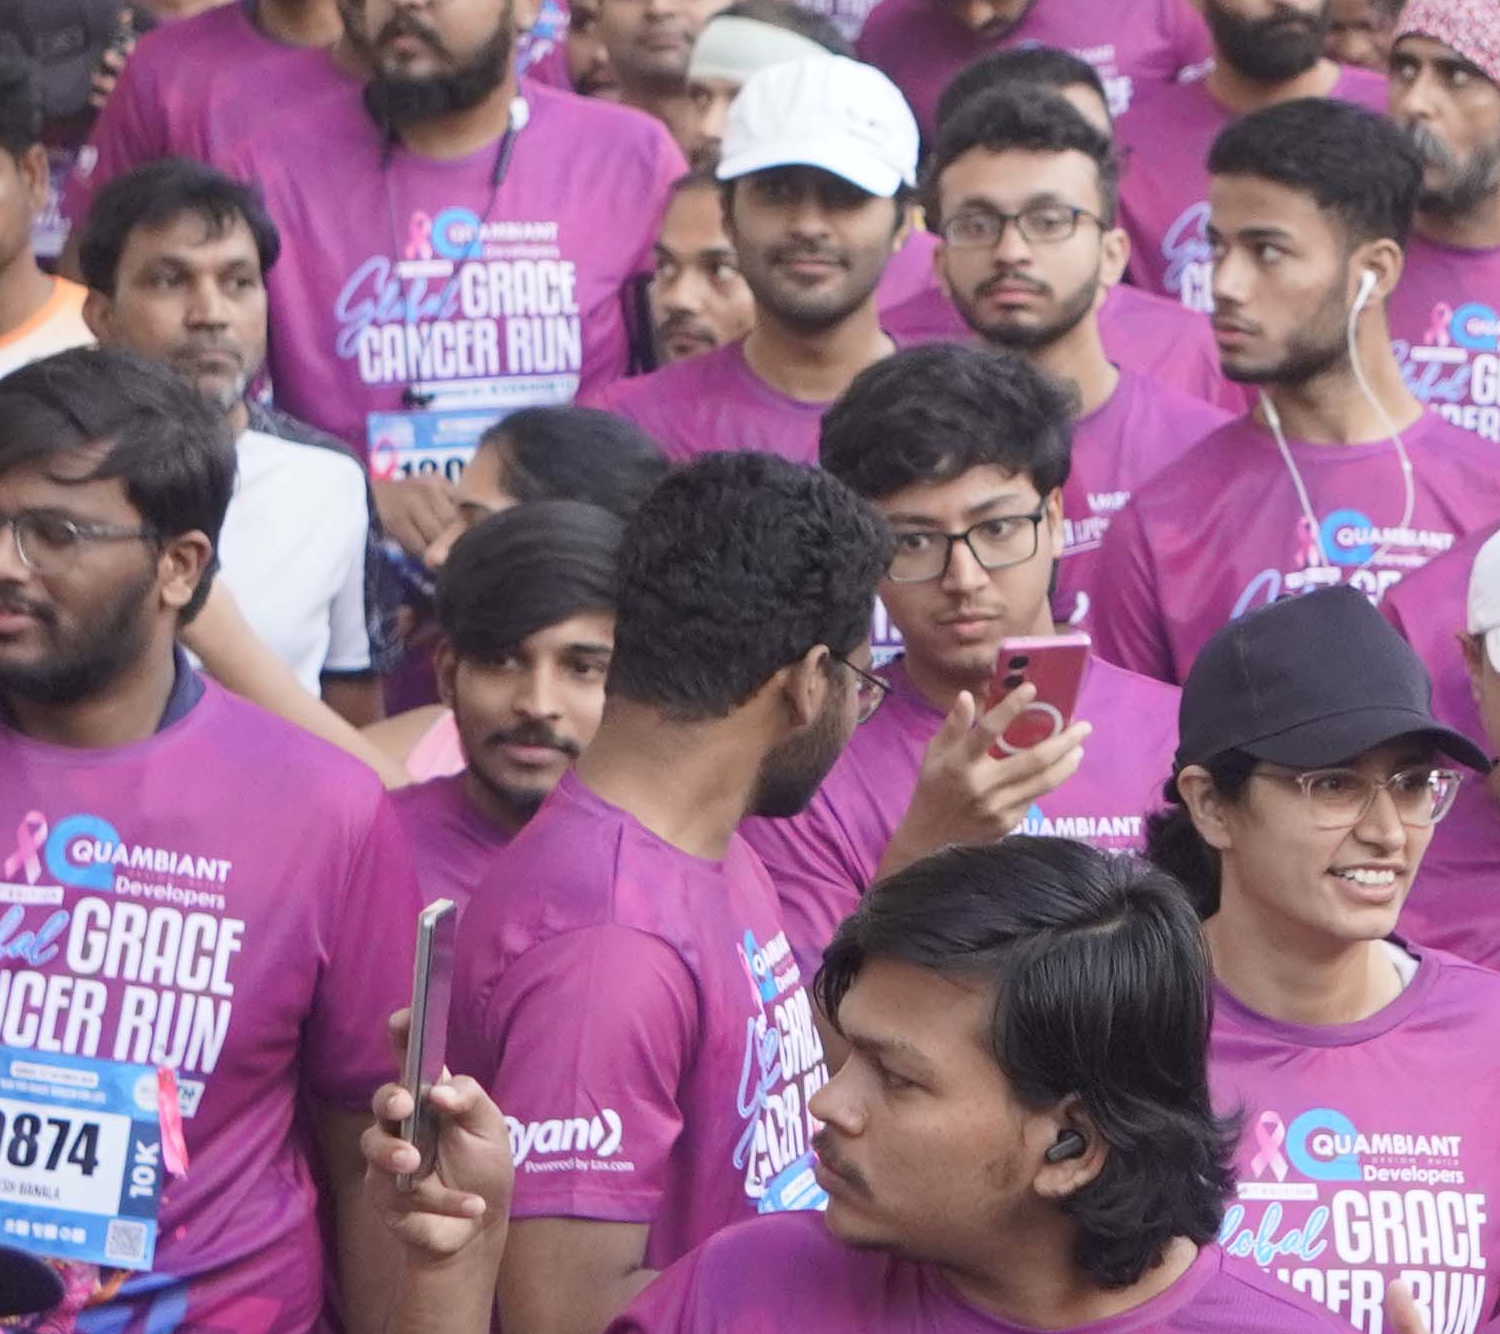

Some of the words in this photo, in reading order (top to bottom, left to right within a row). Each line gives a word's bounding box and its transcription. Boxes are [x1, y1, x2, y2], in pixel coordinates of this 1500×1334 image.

[462, 262, 579, 319] GRACE
[358, 320, 499, 384] CANCER
[505, 317, 582, 376] RUN
[1336, 526, 1455, 552] QUAMBIANT
[72, 838, 232, 883] QUAMBIANT
[114, 875, 226, 911] Developers
[67, 897, 246, 997] GRACE
[114, 988, 232, 1074] RUN
[128, 1141, 161, 1199] 10K
[525, 1157, 572, 1175] Powered
[1312, 1133, 1462, 1159] QUAMBIANT
[1362, 1165, 1465, 1187] Developers
[1217, 1201, 1328, 1263] lobal
[1332, 1189, 1487, 1269] GRACE
